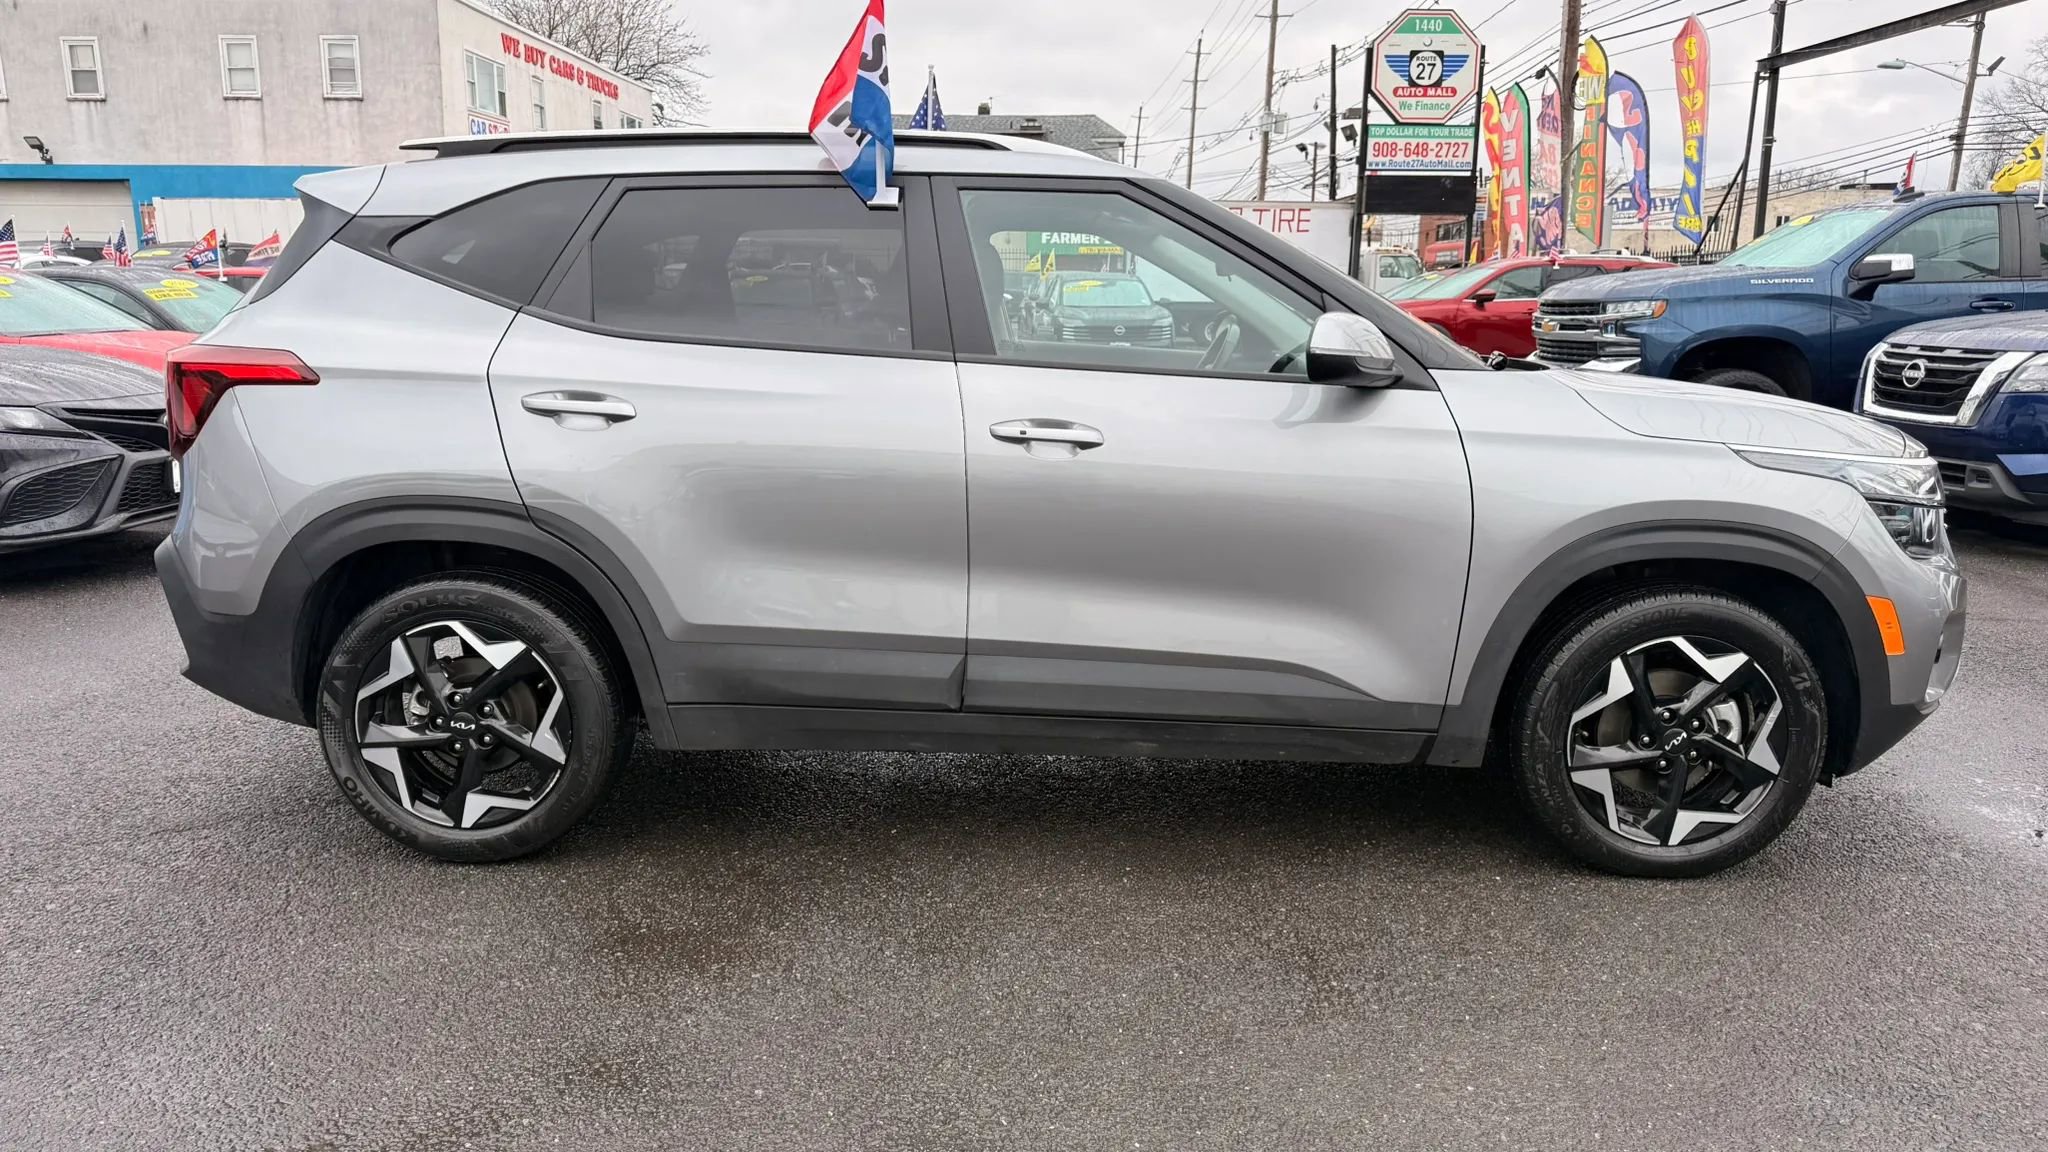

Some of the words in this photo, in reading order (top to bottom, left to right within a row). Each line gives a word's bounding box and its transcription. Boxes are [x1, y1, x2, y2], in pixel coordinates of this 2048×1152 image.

[1415, 19, 1442, 31] 1440
[501, 33, 520, 58] WE
[524, 44, 546, 69] BUY
[549, 55, 575, 81] CARS
[577, 67, 585, 85] &
[586, 71, 619, 100] TRUCKS
[1415, 63, 1437, 80] 27
[1396, 88, 1424, 96] AUTO
[1427, 88, 1454, 96] MALL
[1399, 101, 1413, 111] We
[1415, 101, 1451, 111] Finance
[470, 119, 488, 136] CAR
[1371, 127, 1384, 136] TOP
[1386, 127, 1413, 136] DOLLAR
[1415, 128, 1429, 136] FOR
[1430, 128, 1449, 136] YOUR
[1451, 128, 1473, 136] TRADE
[1372, 141, 1469, 158] 908-648-2727
[1368, 159, 1472, 168] www.Route27AutoMall.com
[1252, 208, 1311, 233] TIRE
